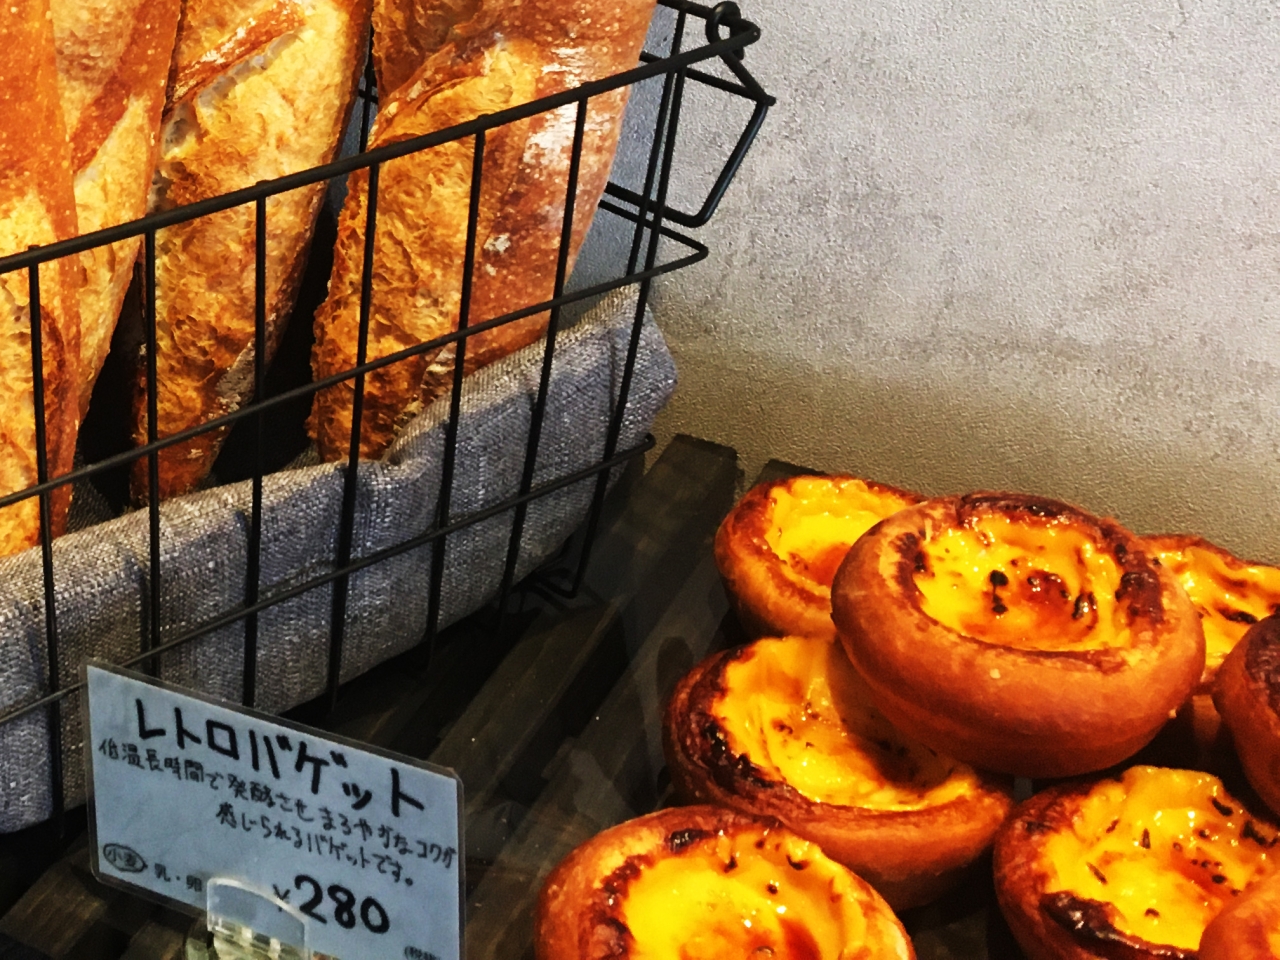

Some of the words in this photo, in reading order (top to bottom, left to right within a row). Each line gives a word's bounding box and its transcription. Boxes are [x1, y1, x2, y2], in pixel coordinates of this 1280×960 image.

[135, 698, 425, 817] レトロバゲット
